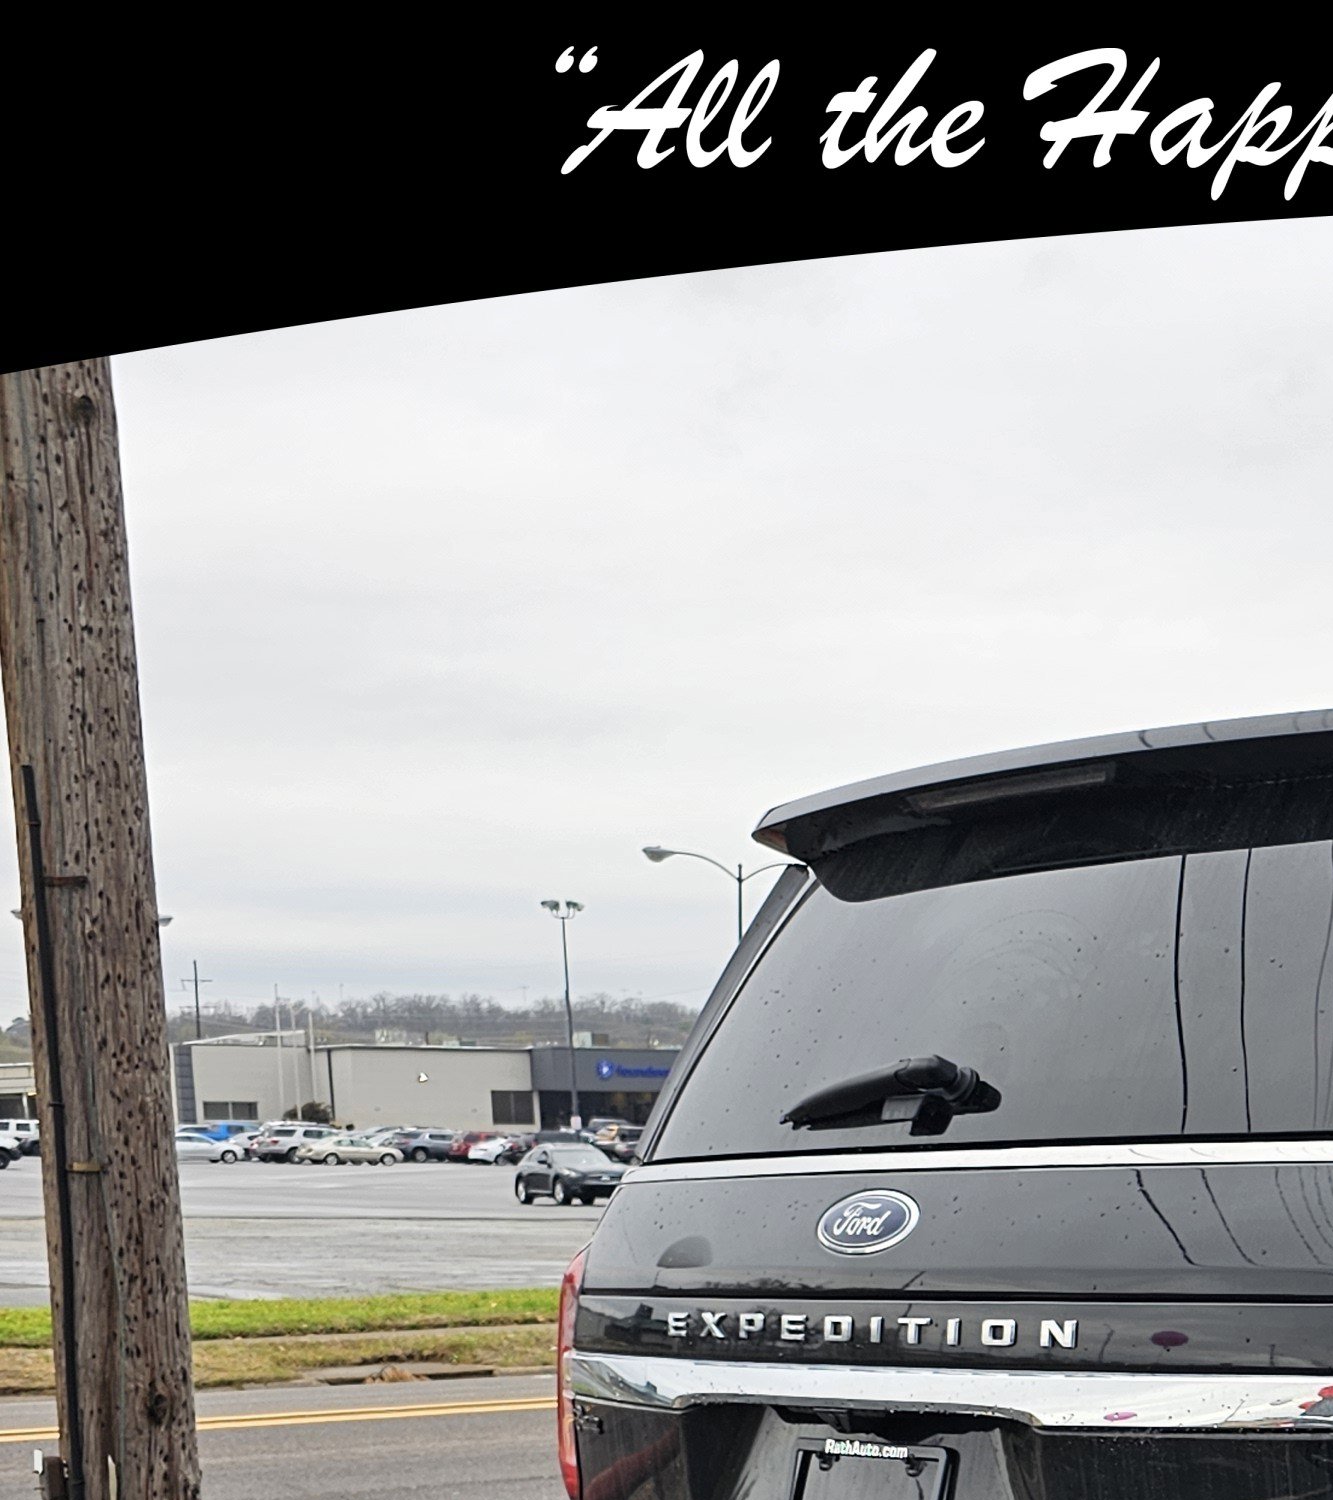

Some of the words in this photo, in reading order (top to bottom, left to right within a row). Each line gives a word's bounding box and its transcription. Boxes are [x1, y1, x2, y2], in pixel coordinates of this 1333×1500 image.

[832, 1201, 892, 1236] Ford
[666, 1310, 1079, 1349] EXPEDITION
[824, 1438, 909, 1459] RathAuto.com
